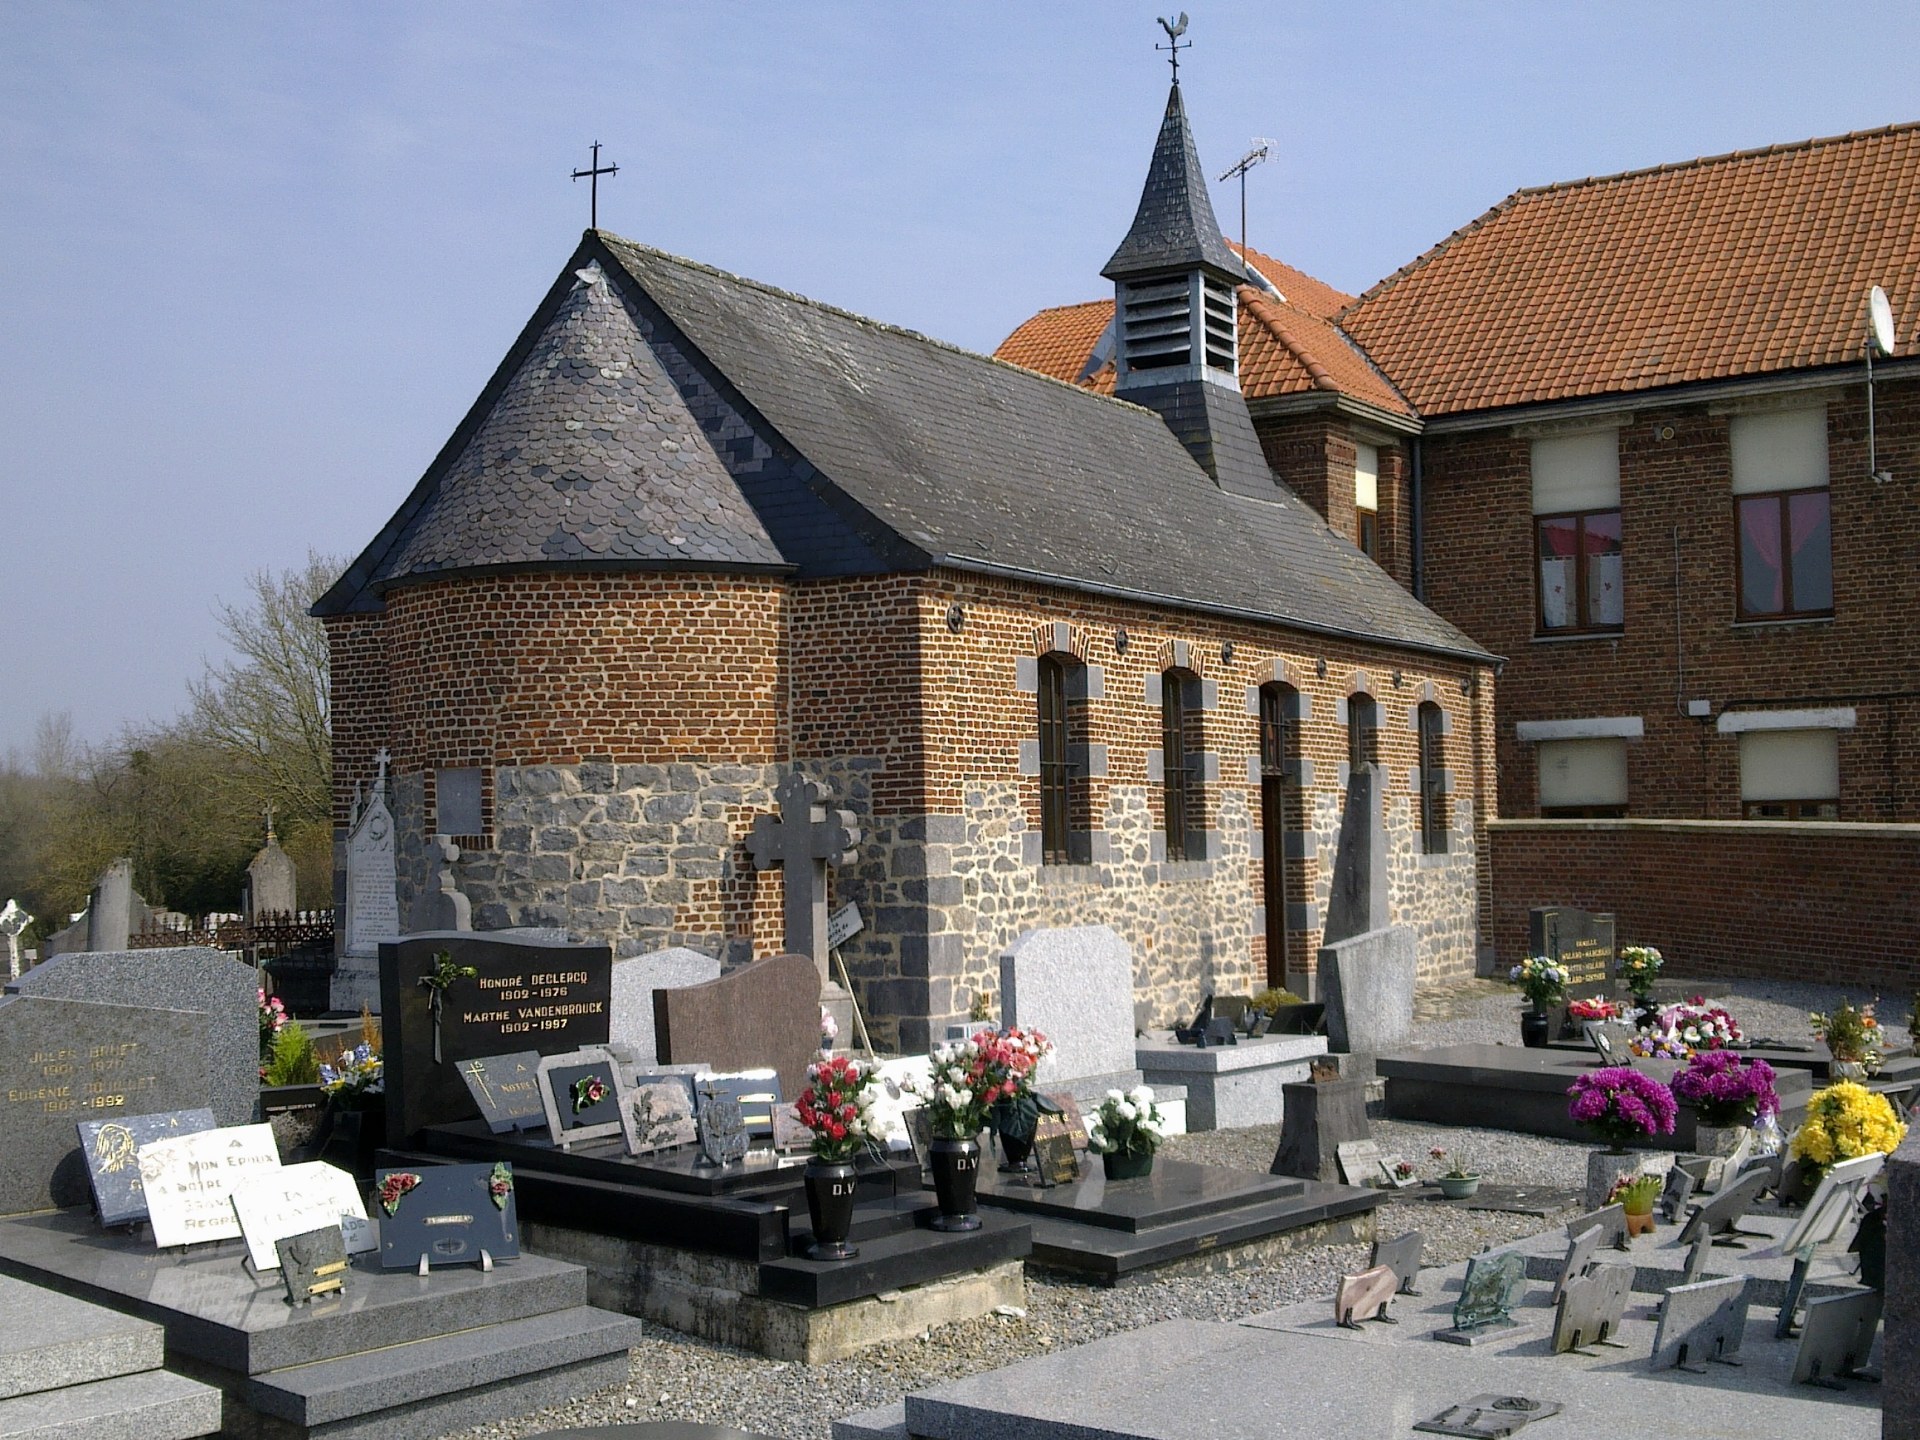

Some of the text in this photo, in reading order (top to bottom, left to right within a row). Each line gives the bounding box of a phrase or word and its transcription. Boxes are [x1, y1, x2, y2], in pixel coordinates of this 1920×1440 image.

[480, 971, 588, 989] HONORÉ DECLERCQ
[463, 1001, 603, 1024] MARTHE VANDENBROUCK
